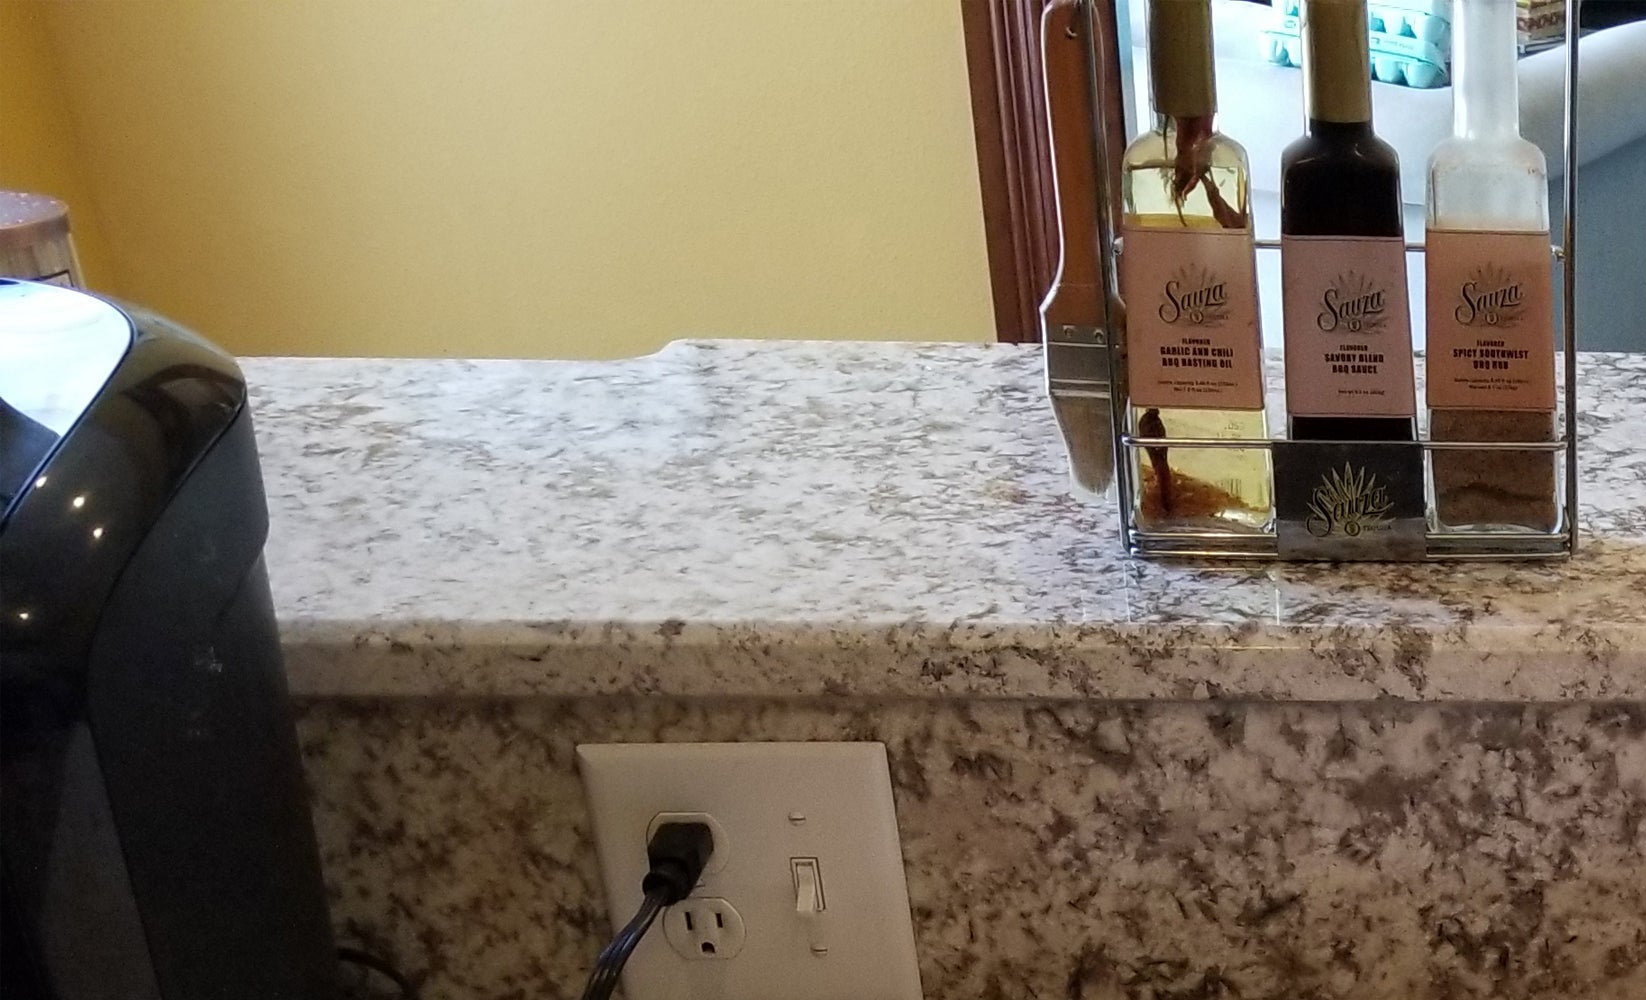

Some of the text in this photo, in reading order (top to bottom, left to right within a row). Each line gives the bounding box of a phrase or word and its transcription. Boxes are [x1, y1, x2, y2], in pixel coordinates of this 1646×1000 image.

[1158, 281, 1227, 324] Sauza
[1455, 282, 1523, 325] Sauza
[1317, 289, 1385, 332] Sauza
[1160, 346, 1234, 358] GARLIC AND CHILI
[1453, 348, 1529, 360] SPICY SOUTHWEST
[1162, 357, 1233, 368] BBQ BASTING OIL
[1325, 354, 1384, 363] SAVORY BLEND
[1332, 365, 1378, 374] BBQ SAUCE
[1473, 360, 1509, 370] BBQ RUB
[1307, 485, 1390, 537] Sauza
